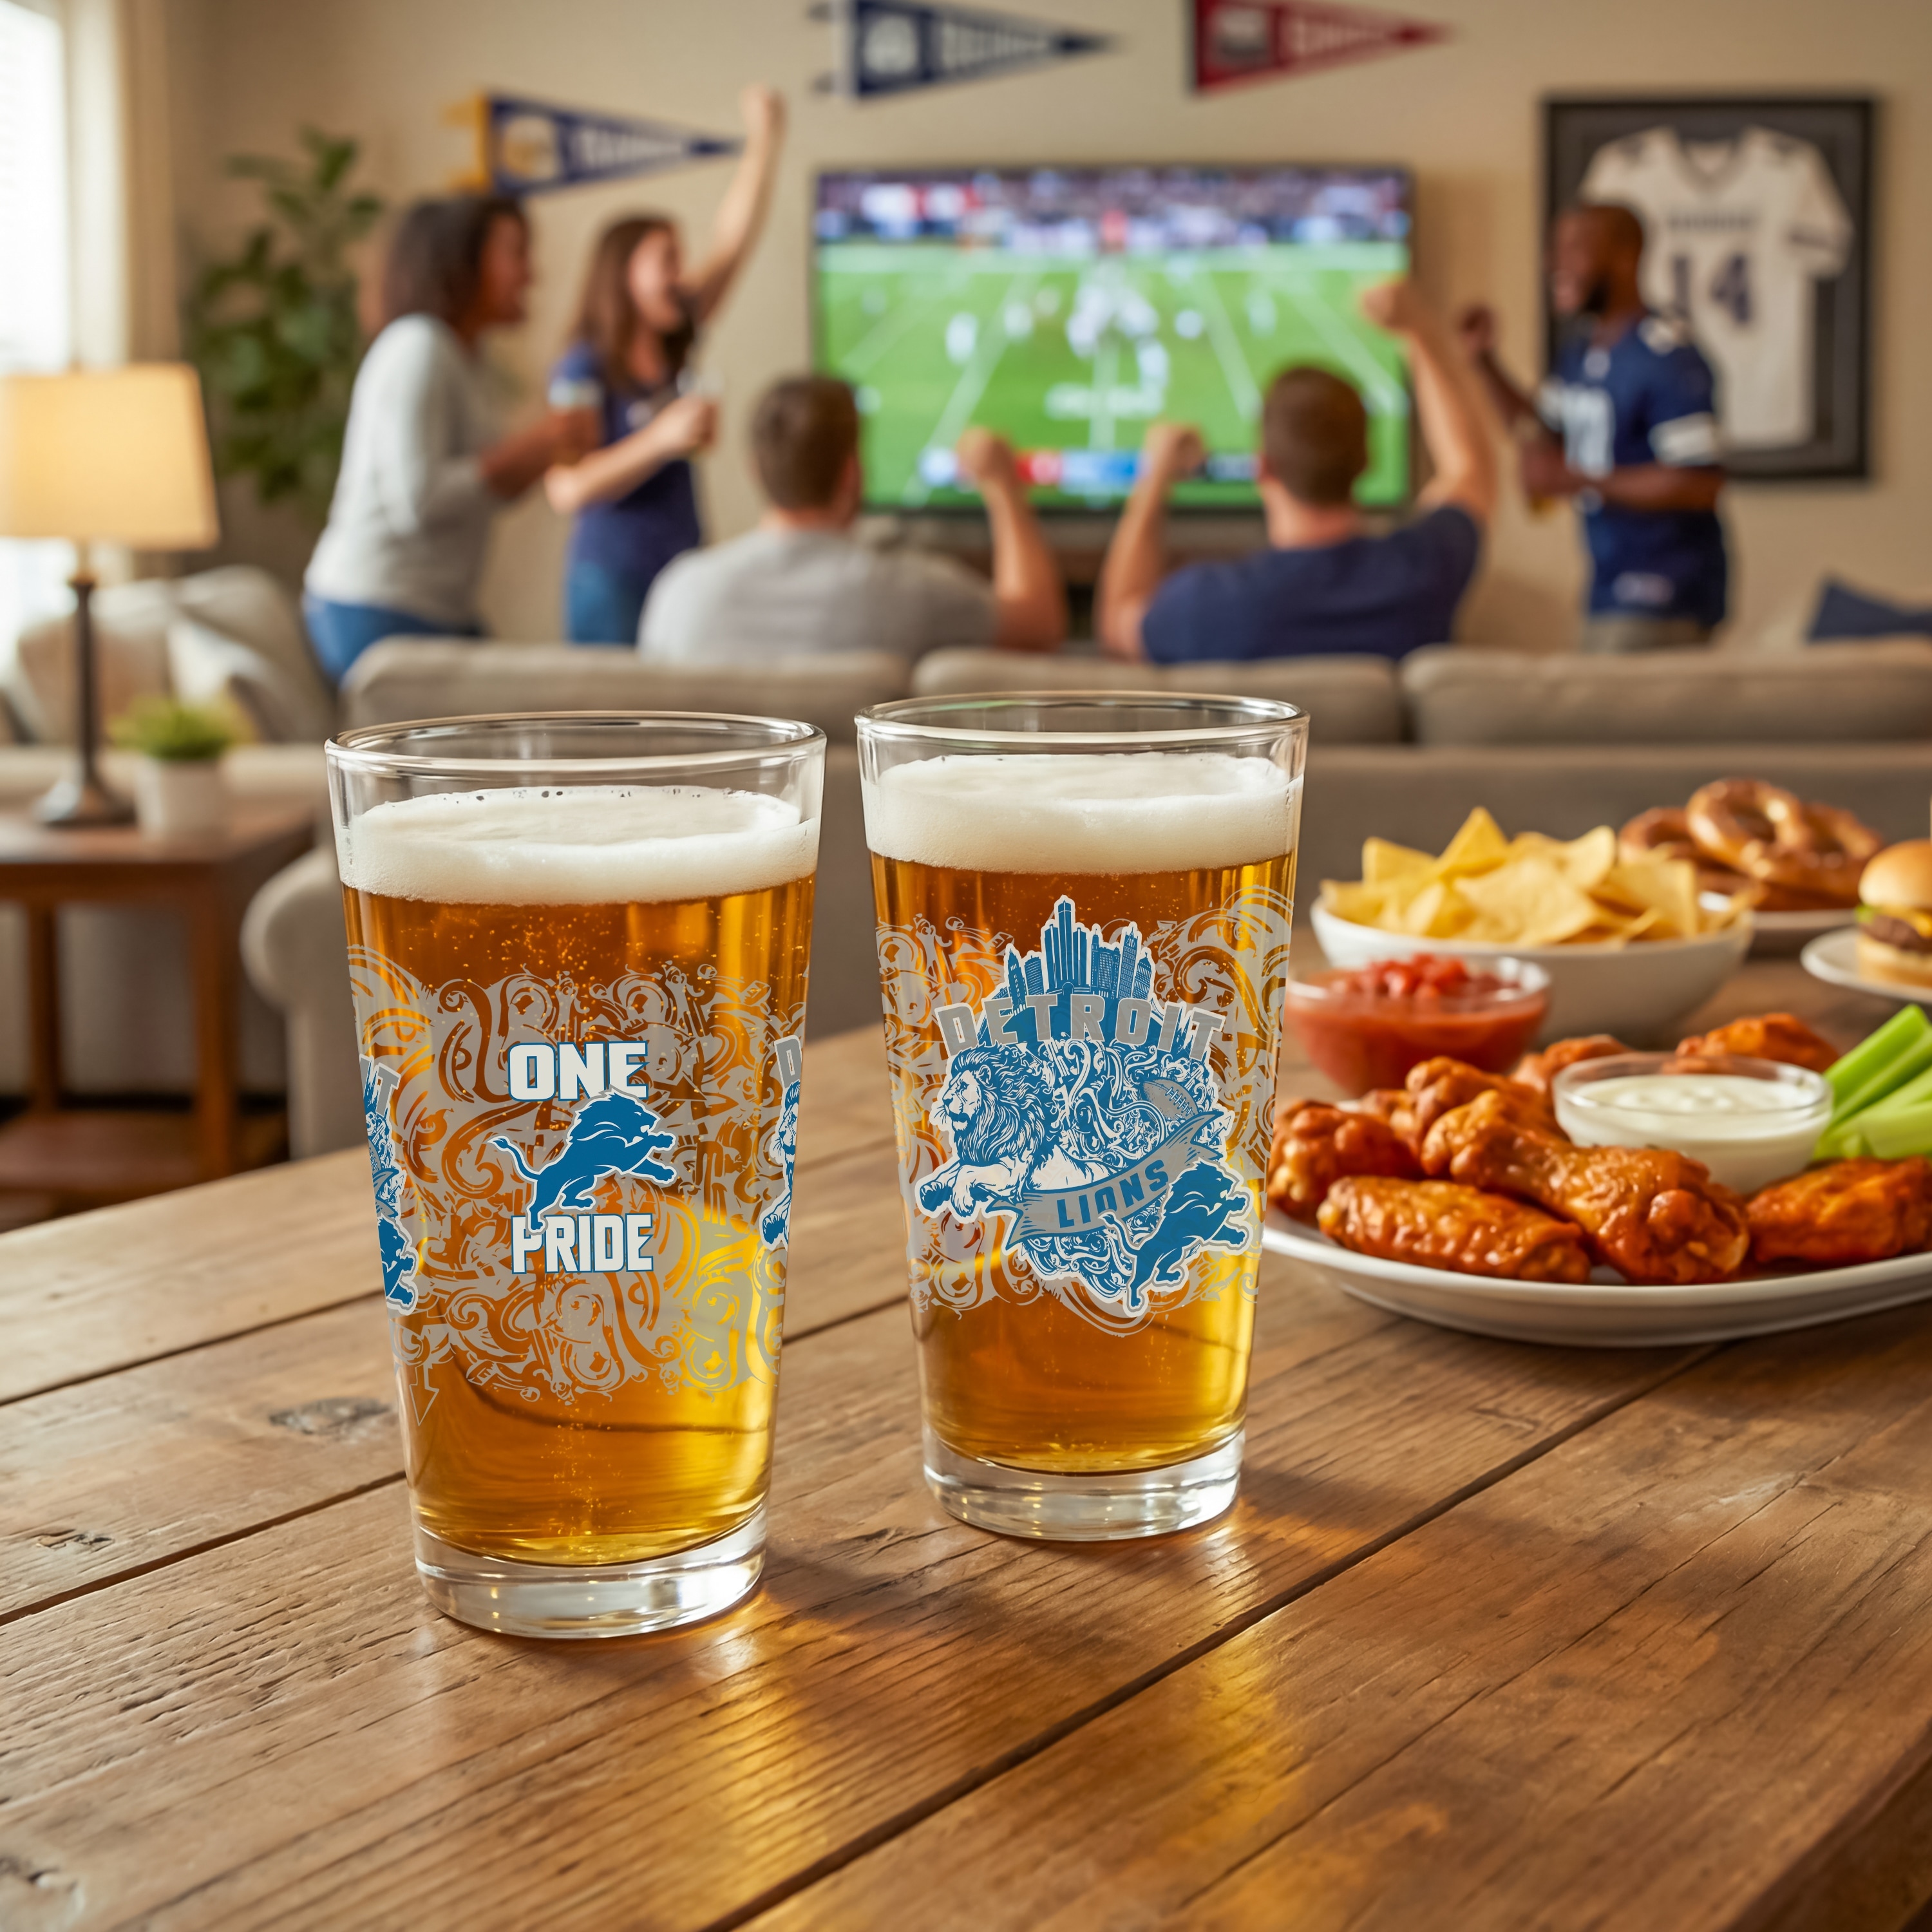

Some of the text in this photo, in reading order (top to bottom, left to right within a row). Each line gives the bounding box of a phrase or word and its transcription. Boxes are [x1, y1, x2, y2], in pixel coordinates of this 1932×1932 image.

[1671, 254, 1753, 325] 14
[935, 994, 1226, 1061] DETROIT
[507, 1041, 650, 1102] ONE
[1056, 1159, 1169, 1228] LIONS
[511, 1213, 654, 1274] PRIDE
